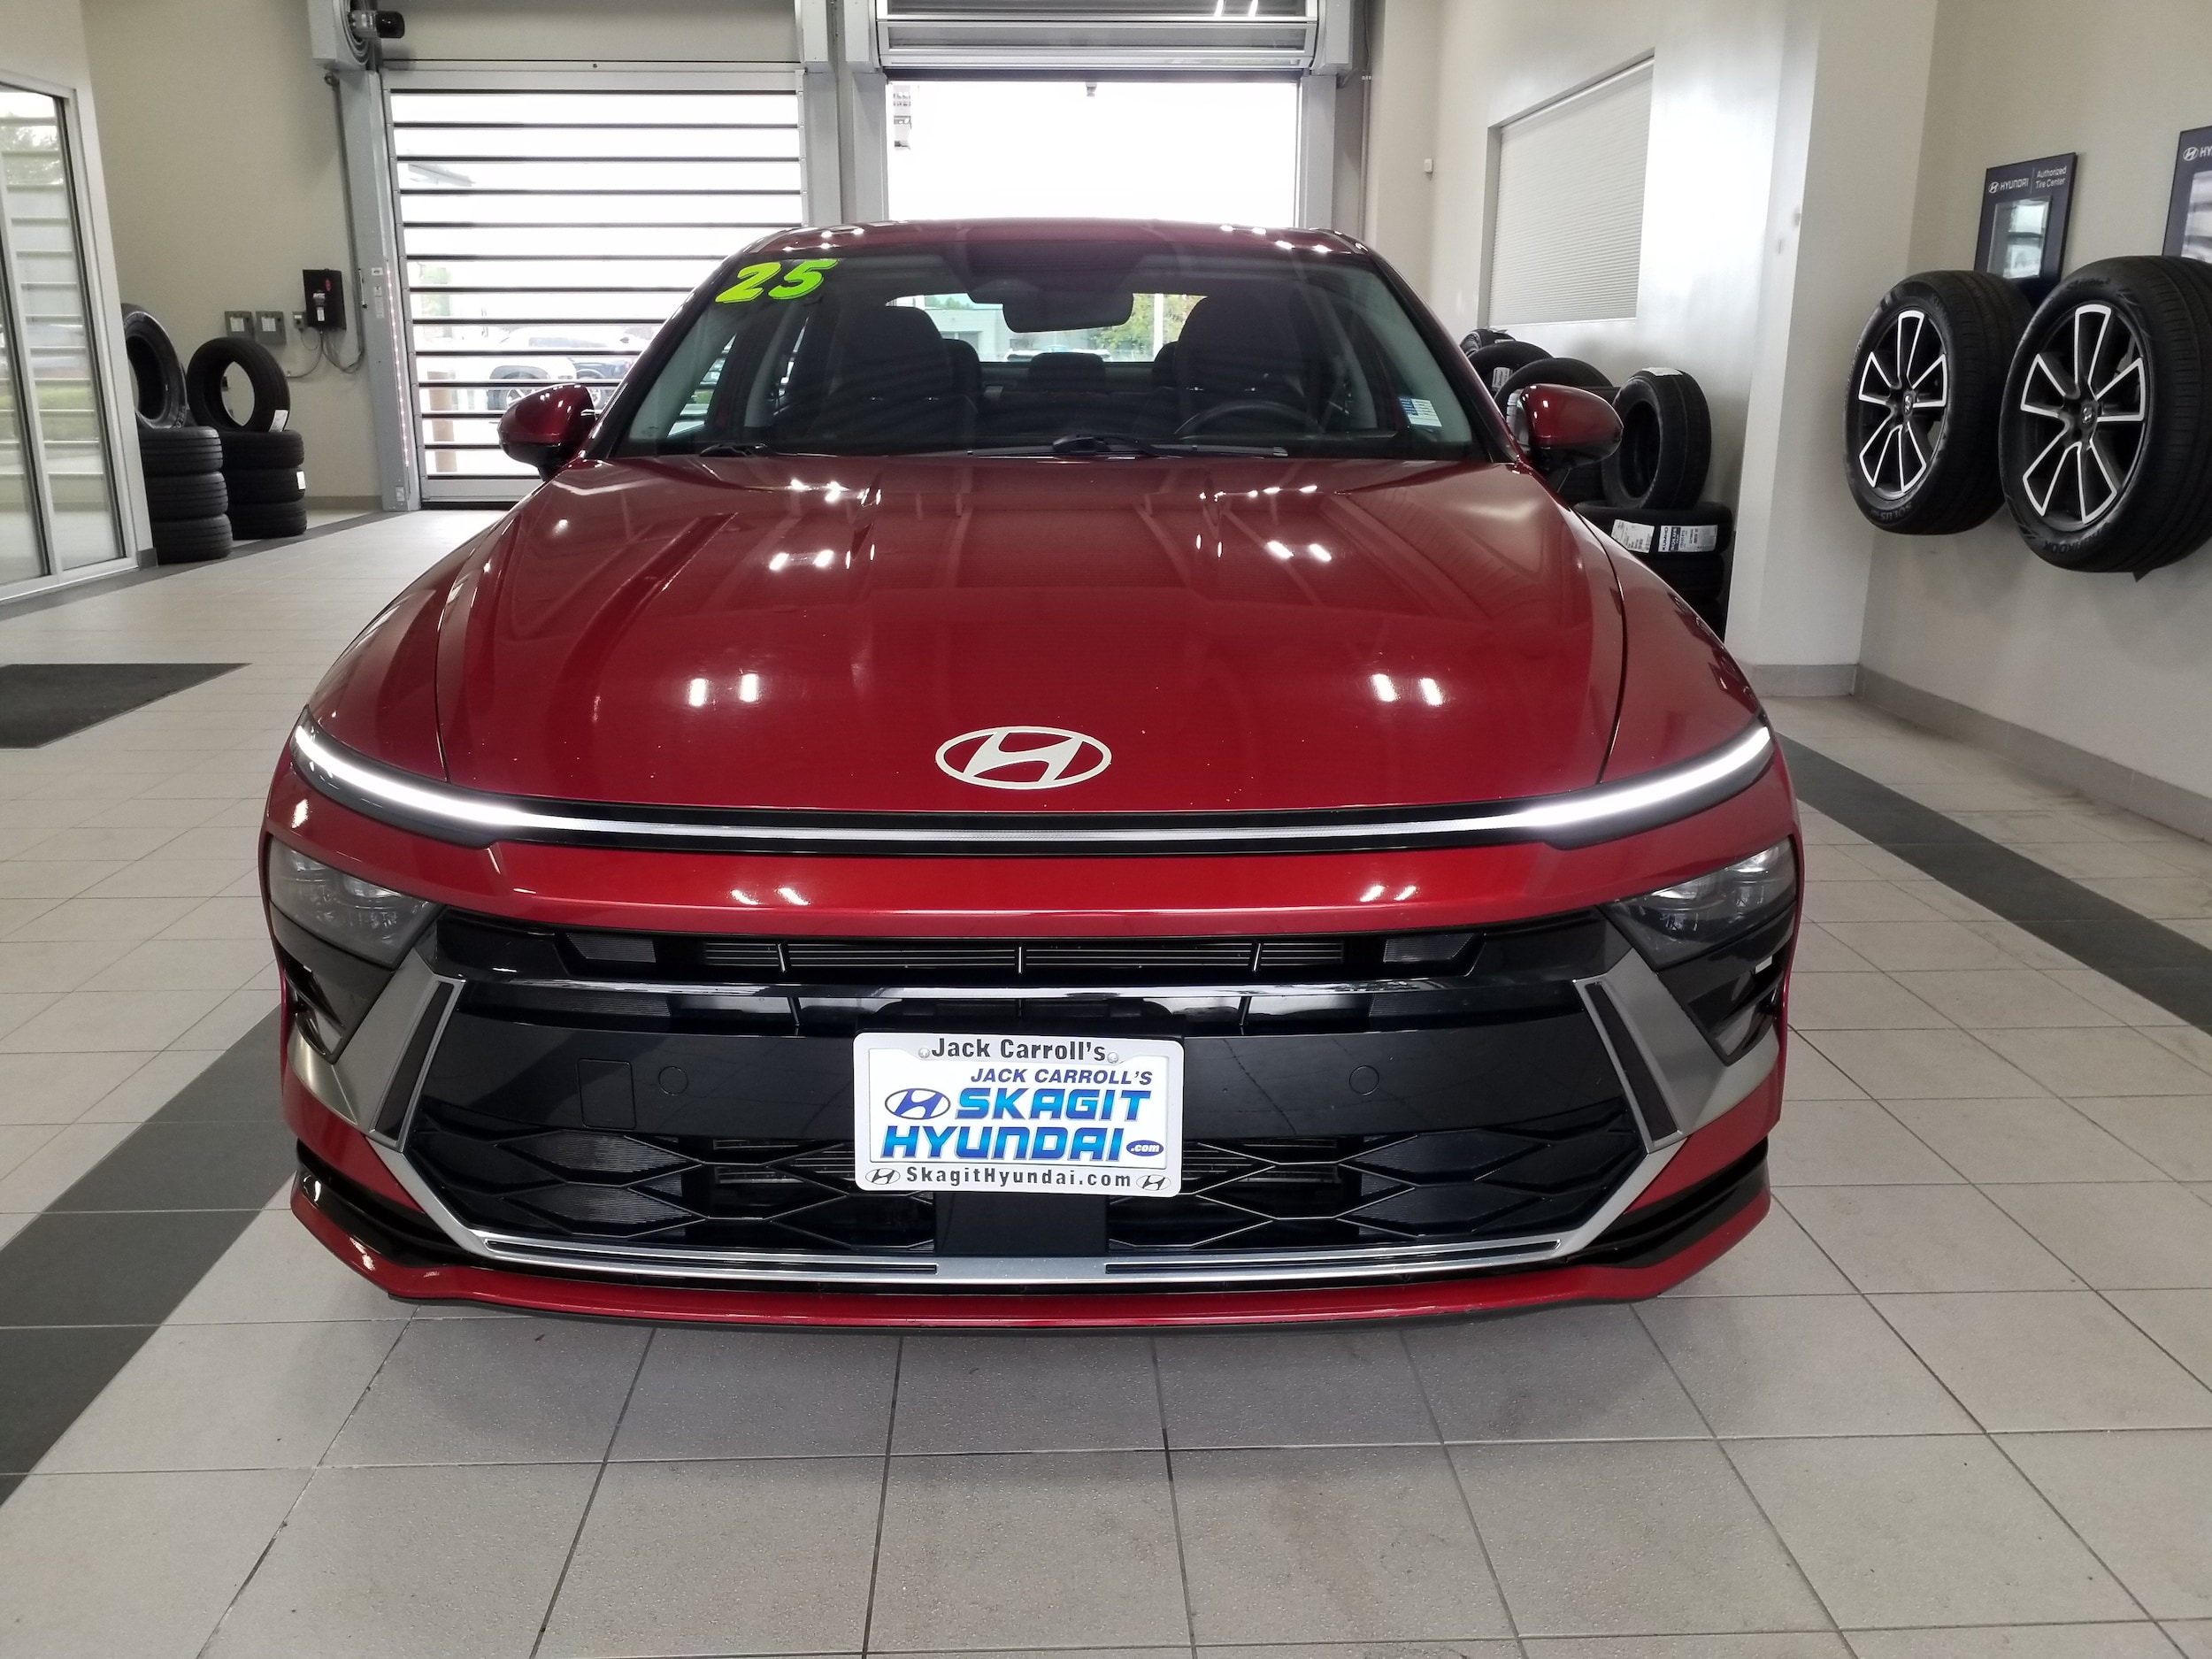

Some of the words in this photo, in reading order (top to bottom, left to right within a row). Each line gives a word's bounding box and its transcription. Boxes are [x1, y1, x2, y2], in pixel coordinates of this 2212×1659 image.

[2199, 145, 2212, 157] HY
[2037, 165, 2067, 178] Authorized
[2000, 178, 2030, 191] HYUNDAI
[2035, 180, 2046, 188] Tire
[2047, 178, 2066, 188] Center
[715, 259, 839, 303] 25
[931, 1038, 991, 1059] Jack
[1000, 1038, 1107, 1062] Carroll's
[971, 1068, 1027, 1083] JACK
[1033, 1068, 1153, 1085] CARROLL'S
[955, 1087, 1152, 1122] SKAGIT
[879, 1125, 1125, 1162] HYUNDAI
[1130, 1143, 1160, 1154] .com
[906, 1166, 1132, 1187] SkagitHyundai.com
